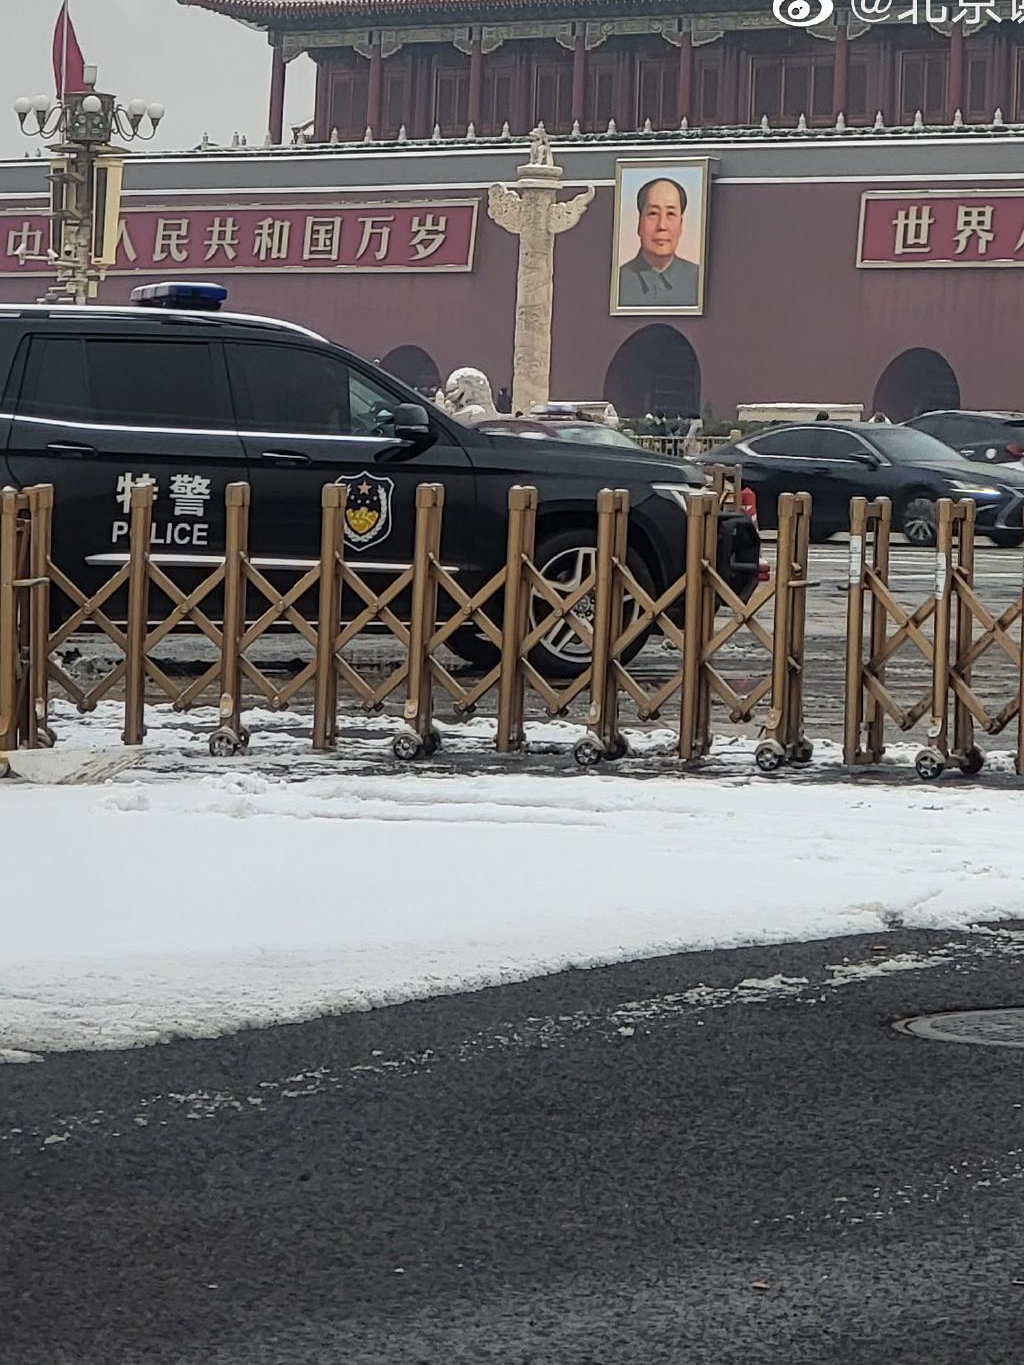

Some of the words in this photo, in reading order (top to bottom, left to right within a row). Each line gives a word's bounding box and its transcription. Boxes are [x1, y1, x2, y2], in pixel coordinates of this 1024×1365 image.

[6, 213, 449, 265] 中人民共和国万岁
[111, 521, 209, 546] PLICE
